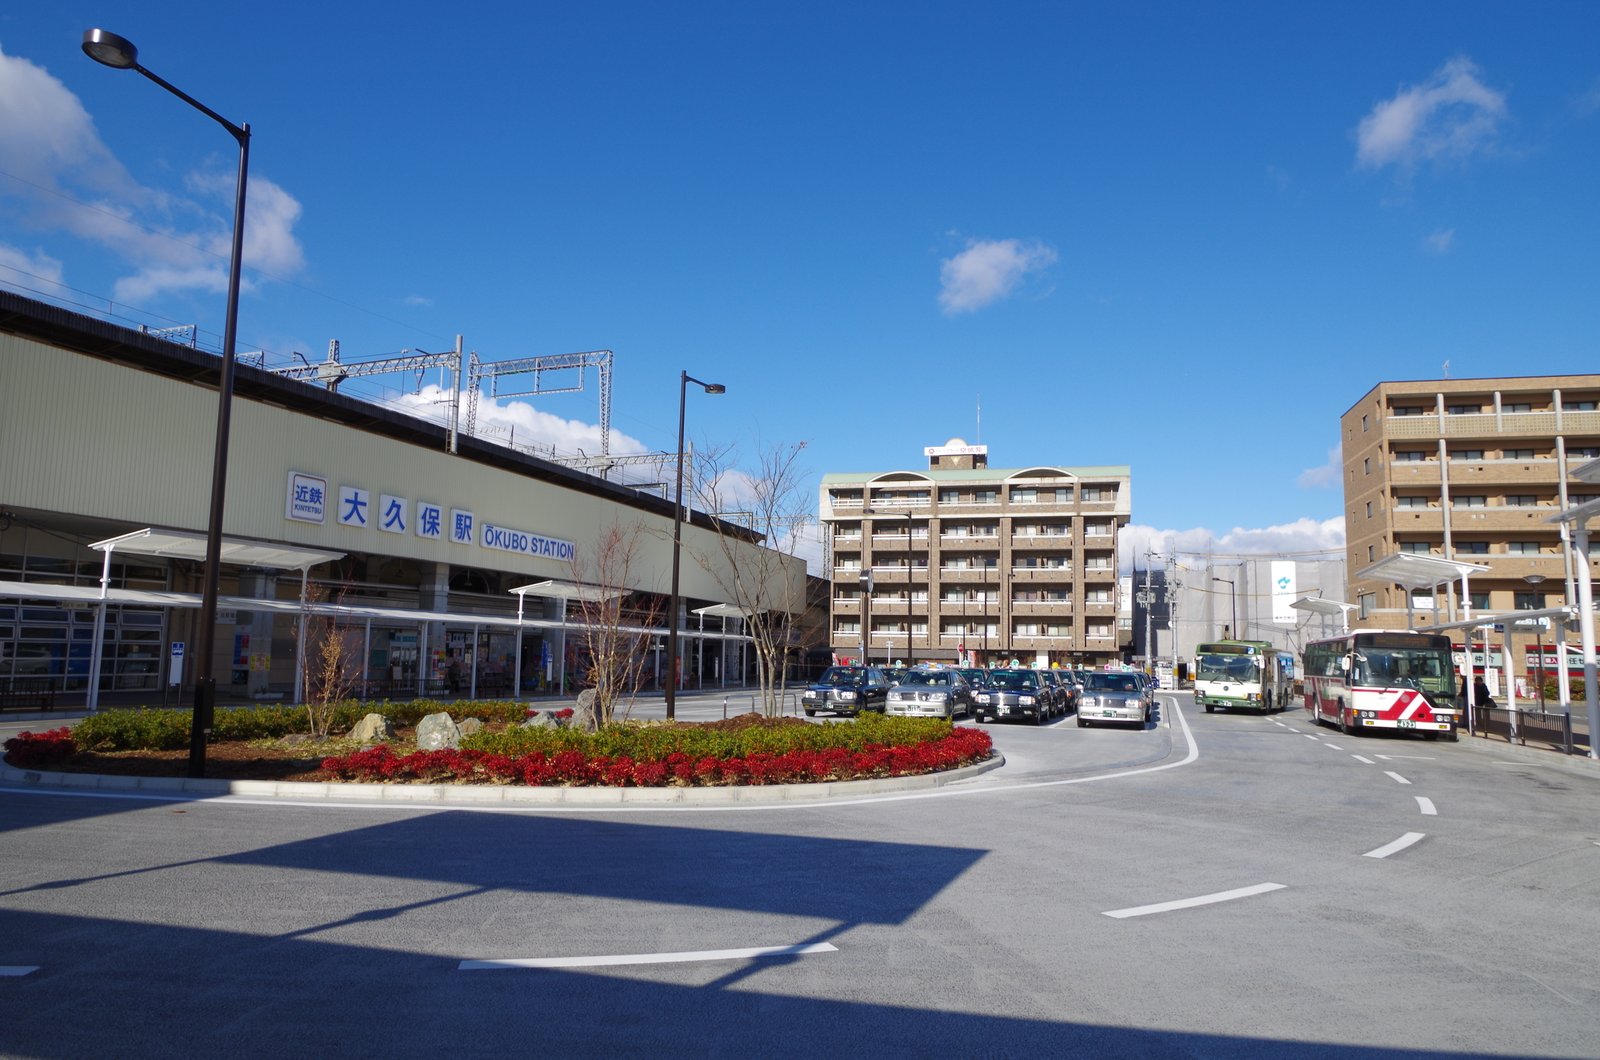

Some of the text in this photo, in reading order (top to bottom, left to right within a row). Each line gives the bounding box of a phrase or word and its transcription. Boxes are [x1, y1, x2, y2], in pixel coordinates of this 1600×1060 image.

[295, 485, 322, 505] 近鉄
[294, 503, 322, 515] KINTETSU
[343, 491, 473, 541] 大久保駅
[531, 537, 574, 561] STATION
